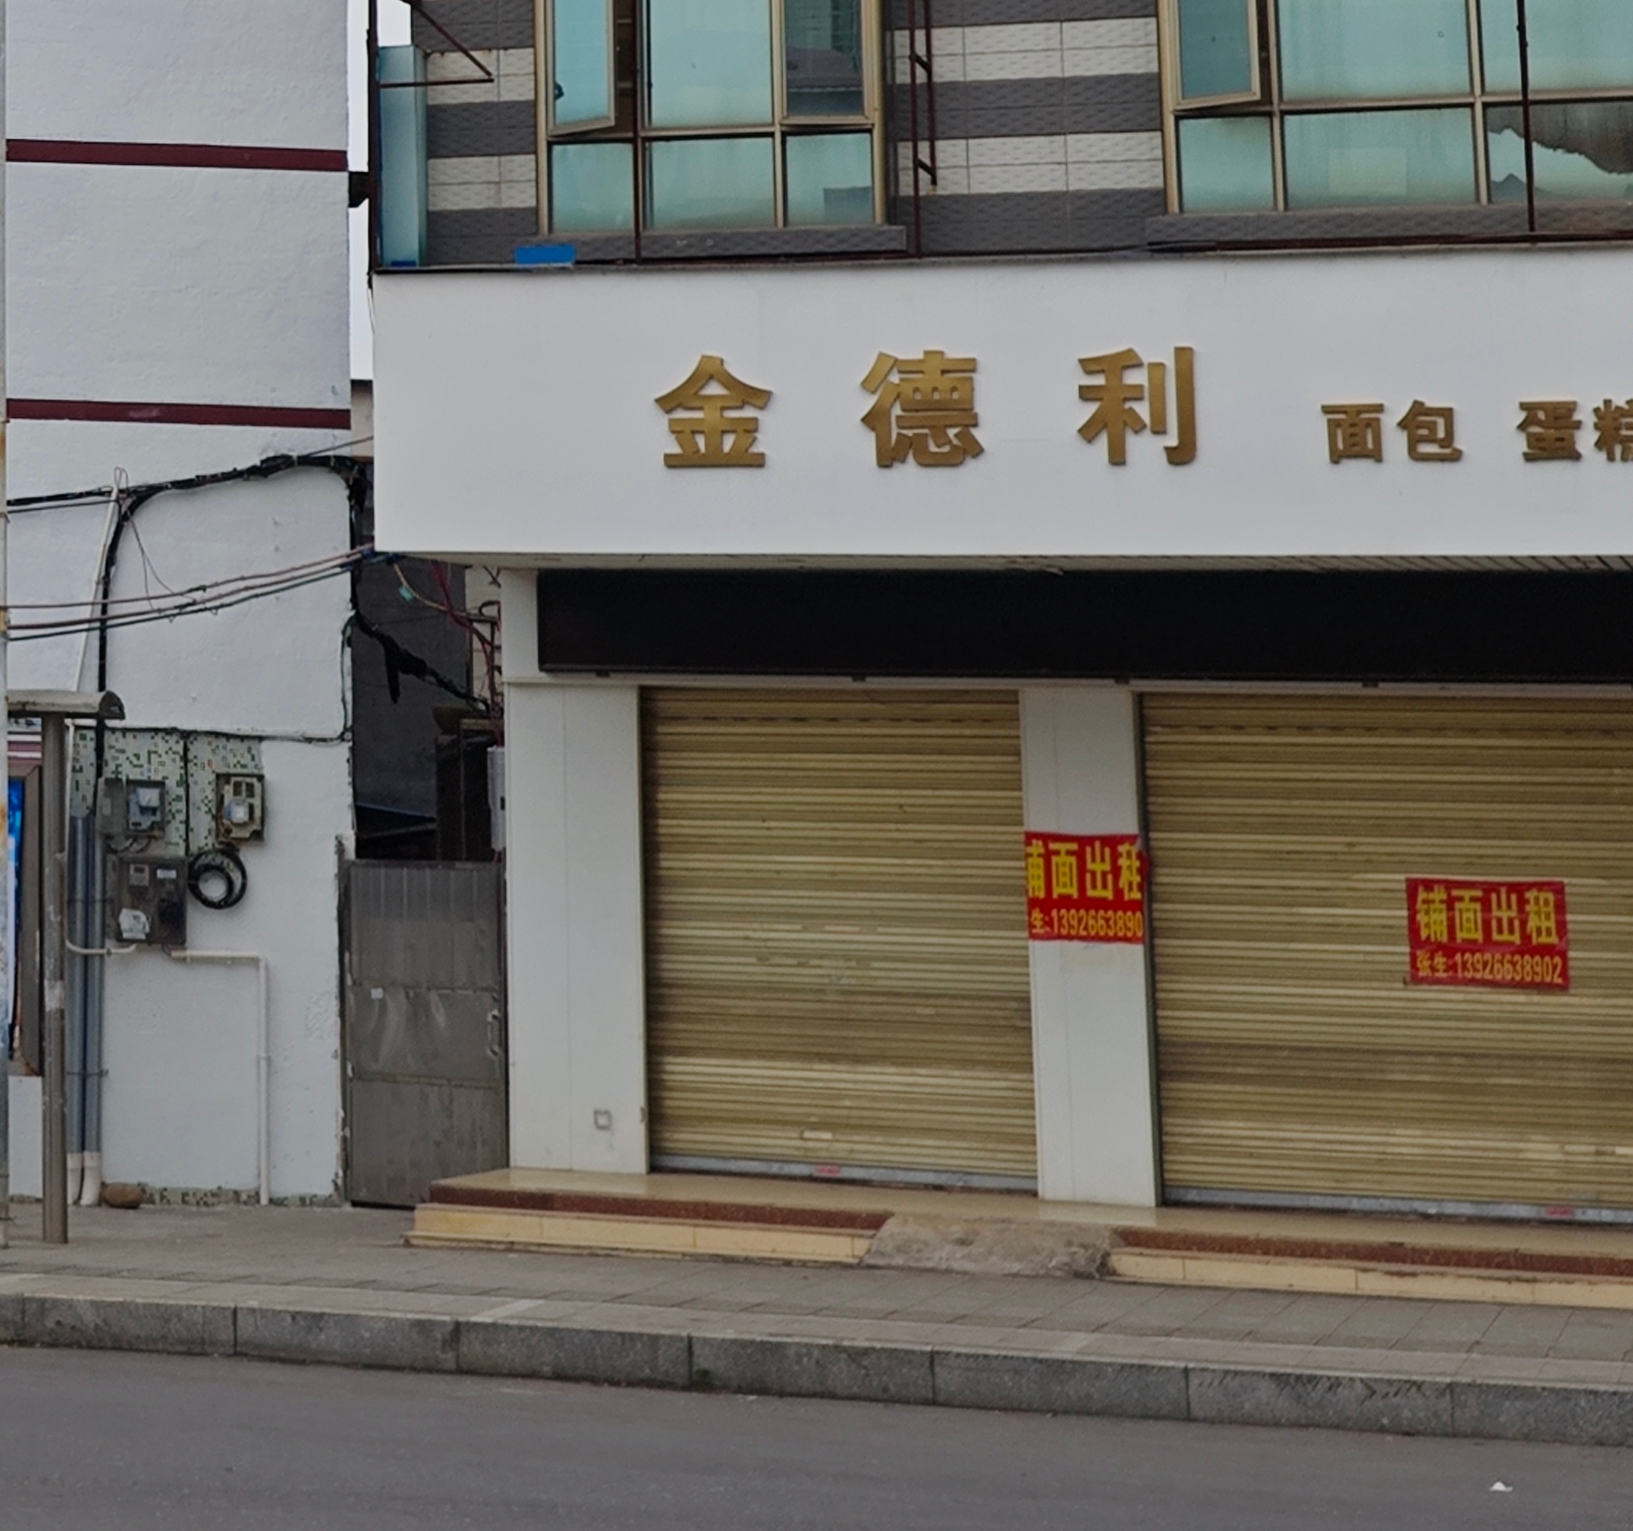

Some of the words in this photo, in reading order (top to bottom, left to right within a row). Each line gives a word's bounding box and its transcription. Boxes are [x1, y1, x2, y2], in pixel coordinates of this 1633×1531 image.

[654, 346, 1197, 468] 金德利
[1321, 399, 1463, 465] 面包
[1416, 885, 1560, 945] 铺面出租
